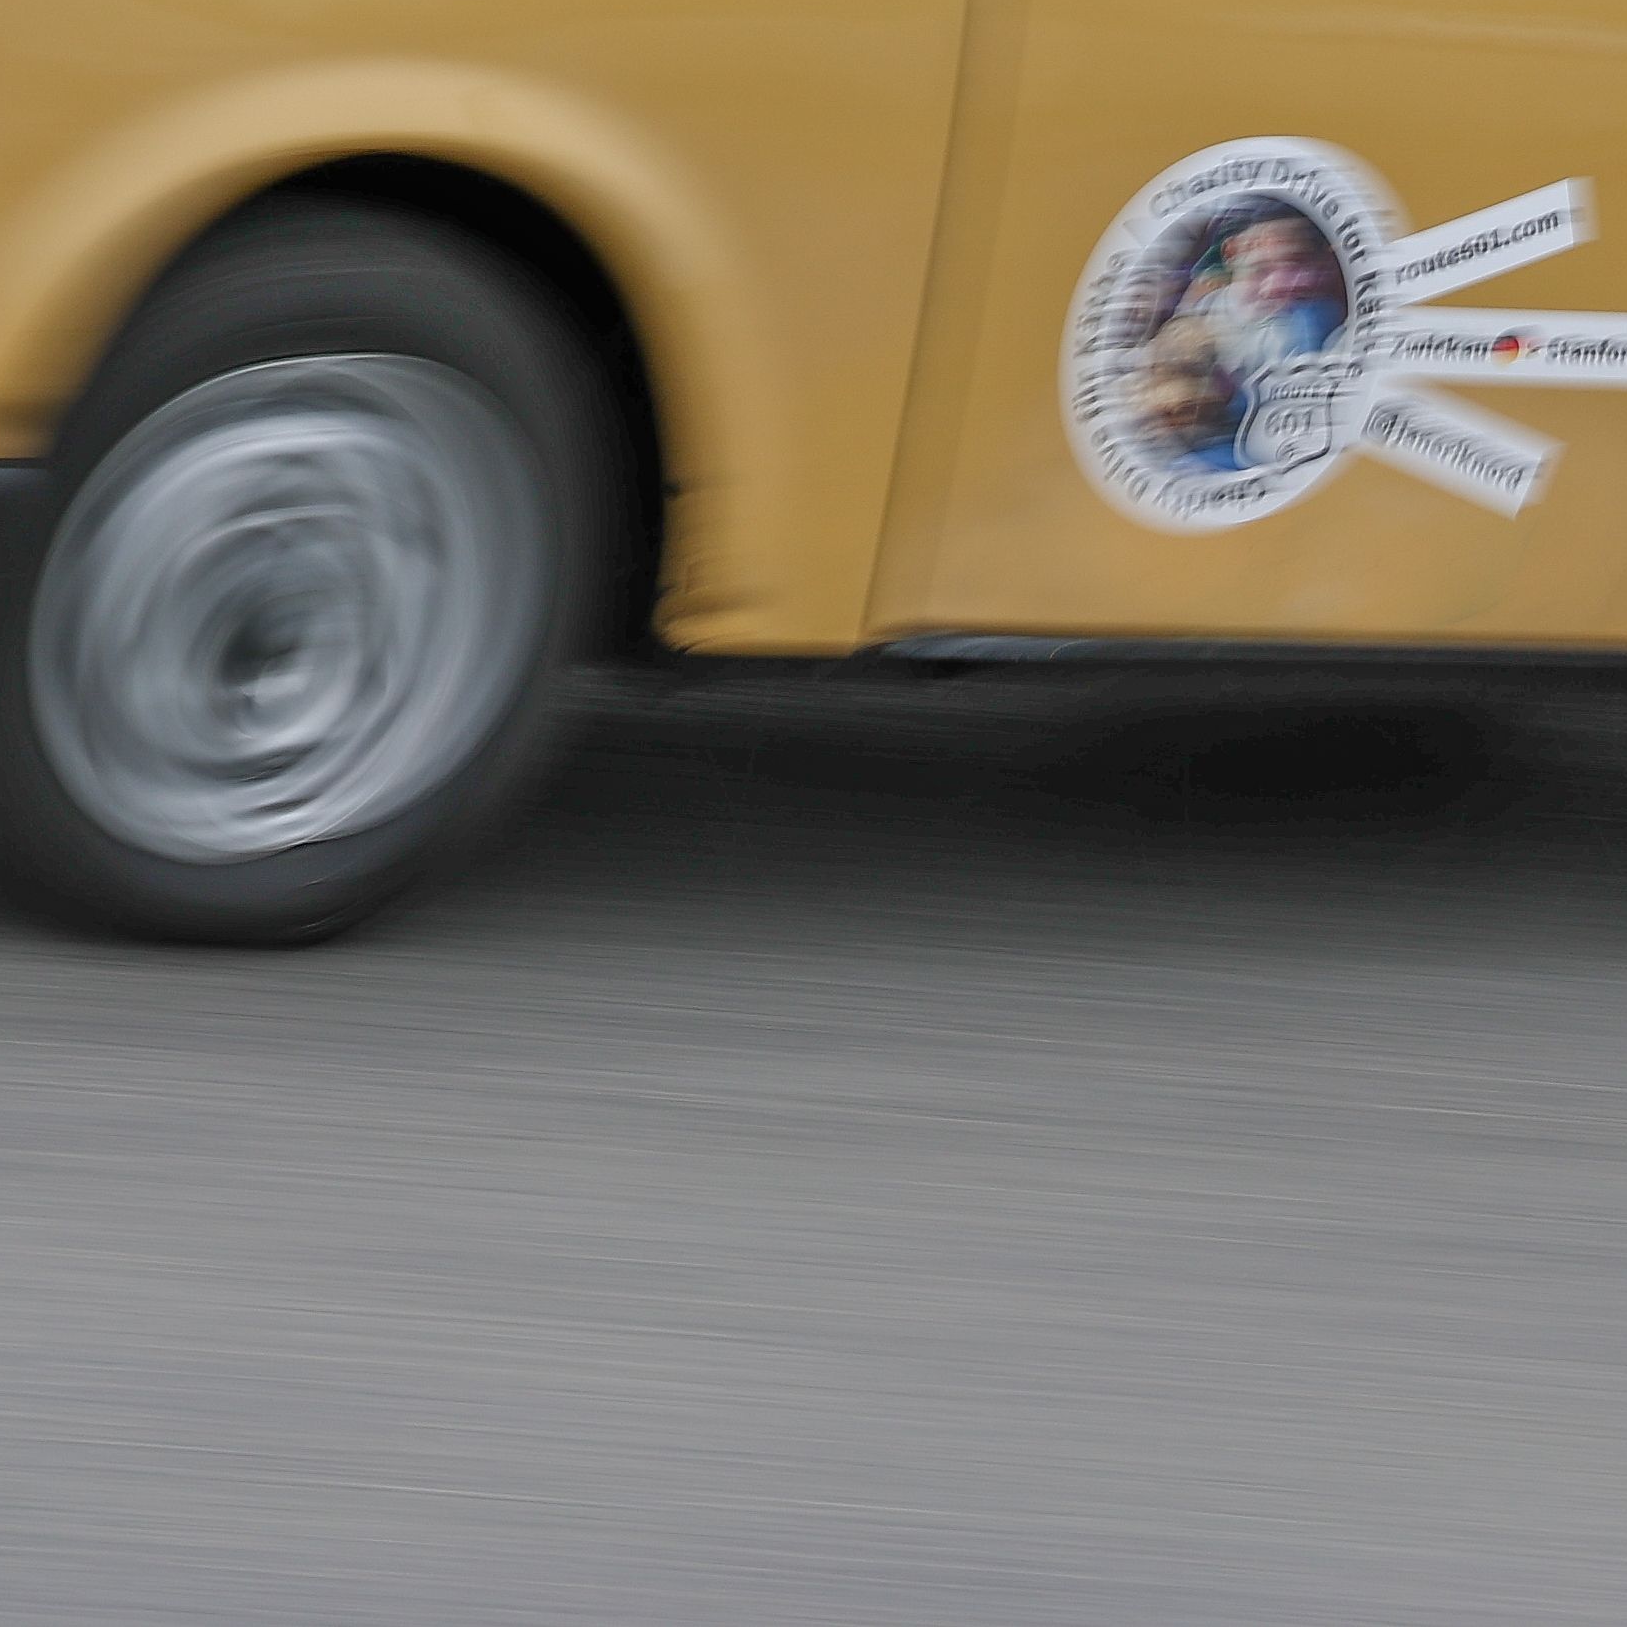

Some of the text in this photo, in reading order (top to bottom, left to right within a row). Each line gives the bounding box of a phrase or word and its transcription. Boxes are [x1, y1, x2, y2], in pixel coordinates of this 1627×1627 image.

[1150, 160, 1262, 221] Charity
[1269, 160, 1340, 221] Drive
[1335, 218, 1368, 266] for
[1394, 210, 1560, 285] route601.com
[1388, 333, 1488, 360] Zwickau
[1265, 409, 1312, 436] 601
